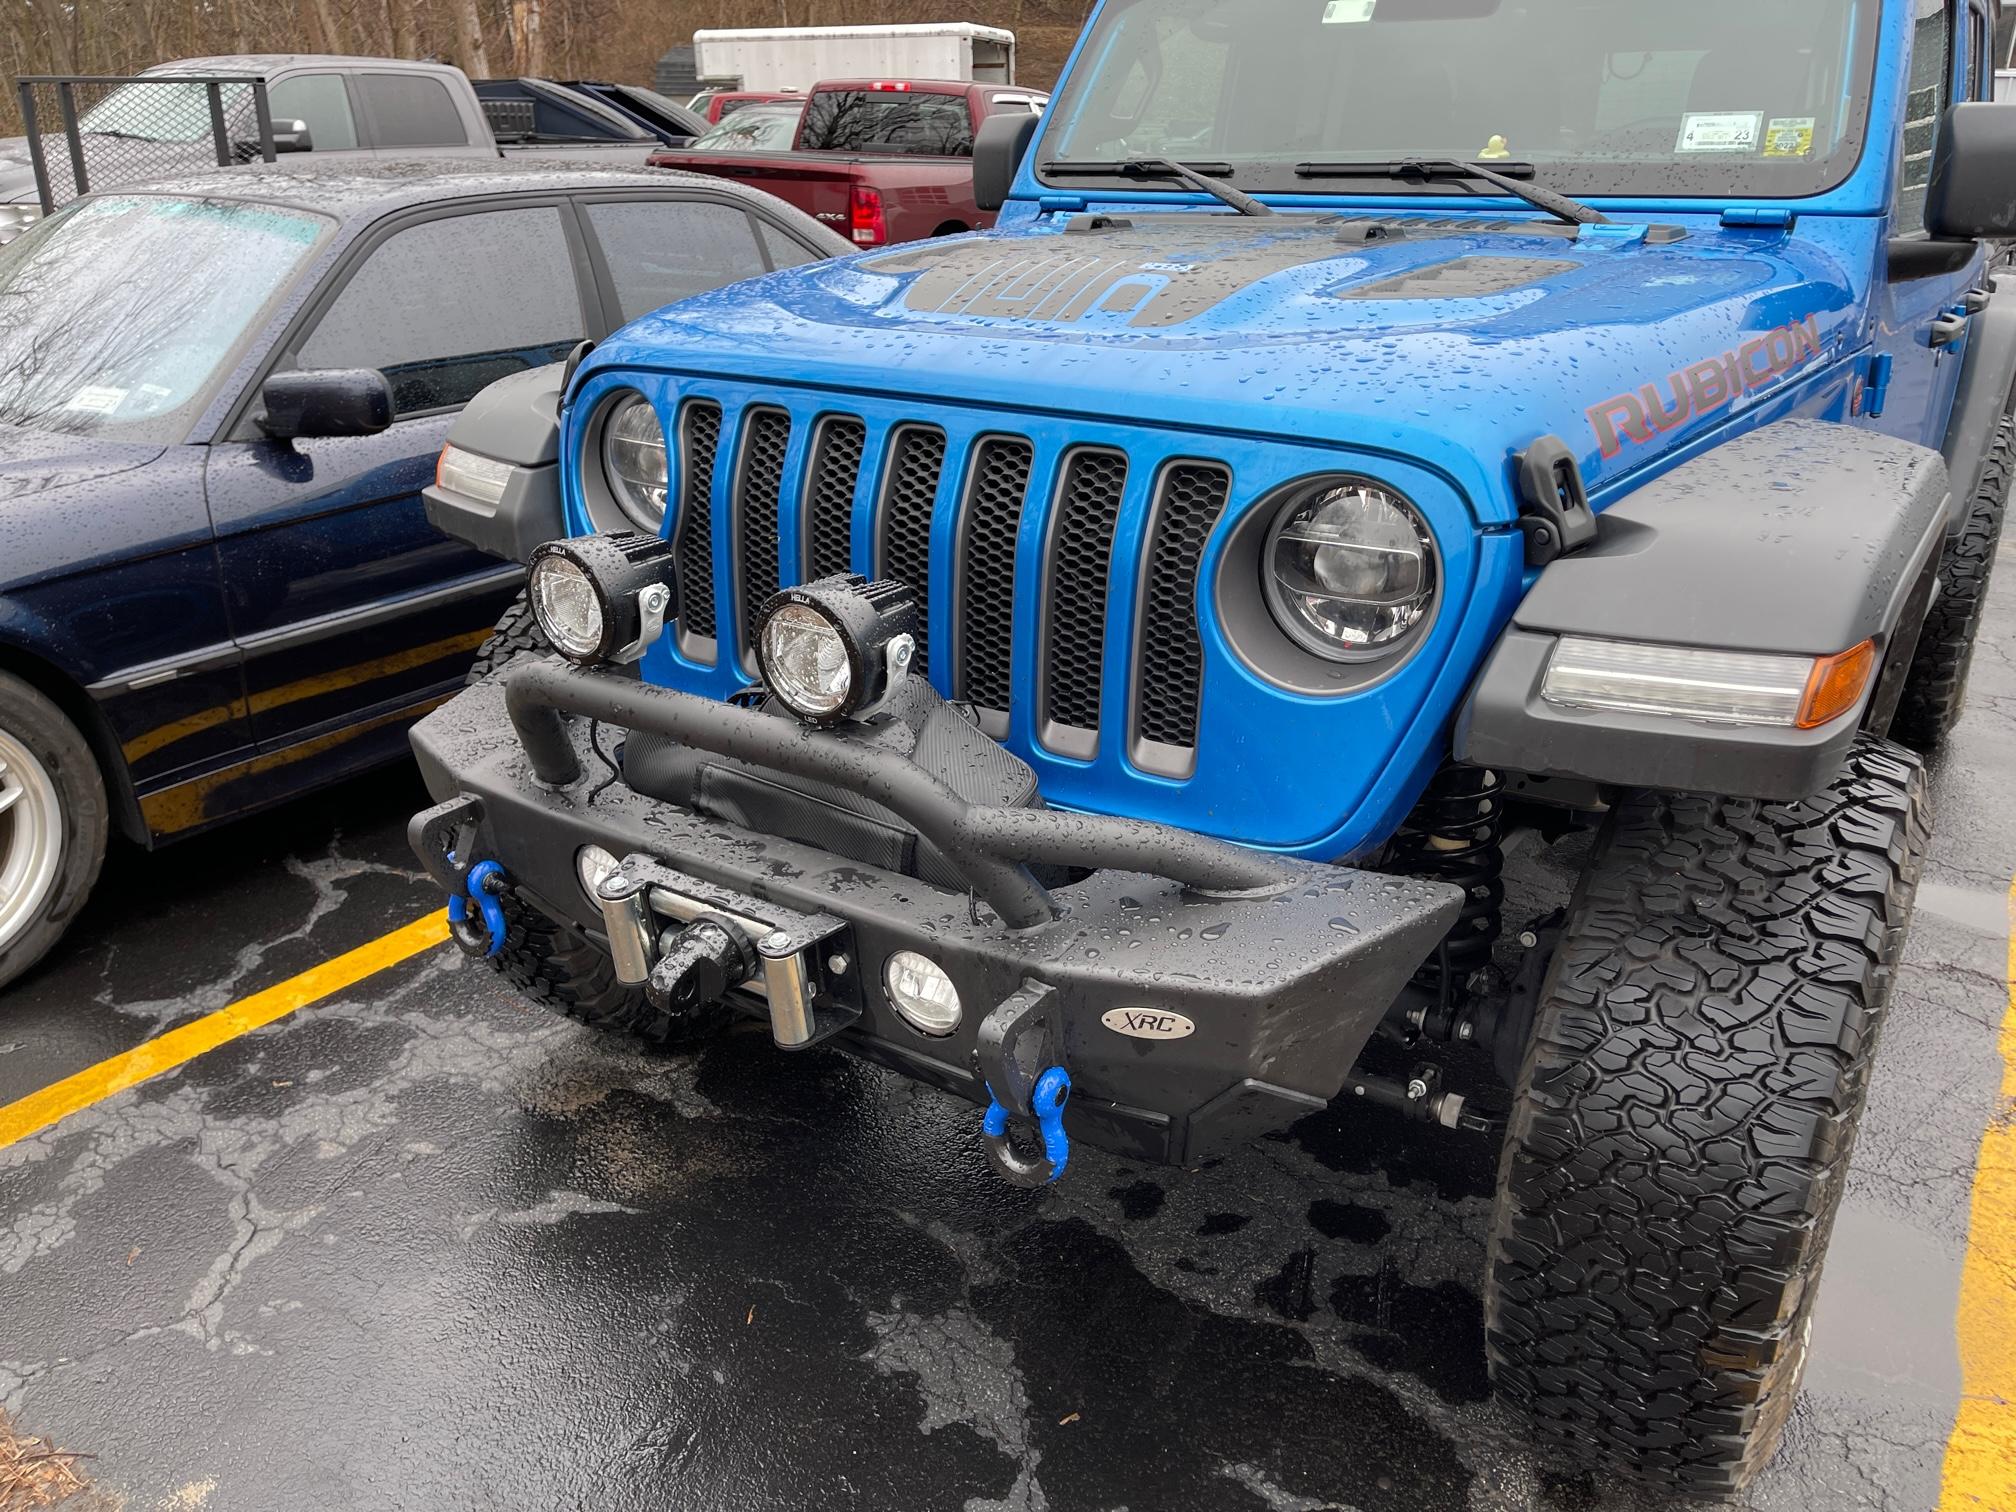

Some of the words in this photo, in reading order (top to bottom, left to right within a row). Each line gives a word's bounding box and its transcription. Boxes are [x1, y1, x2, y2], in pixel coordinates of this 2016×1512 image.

[1734, 129, 1750, 141] 23
[1586, 313, 1821, 459] RUBICON
[549, 545, 566, 556] HELLA
[790, 593, 810, 605] HELLA
[804, 715, 818, 724] LED
[1120, 1011, 1176, 1032] XRC
